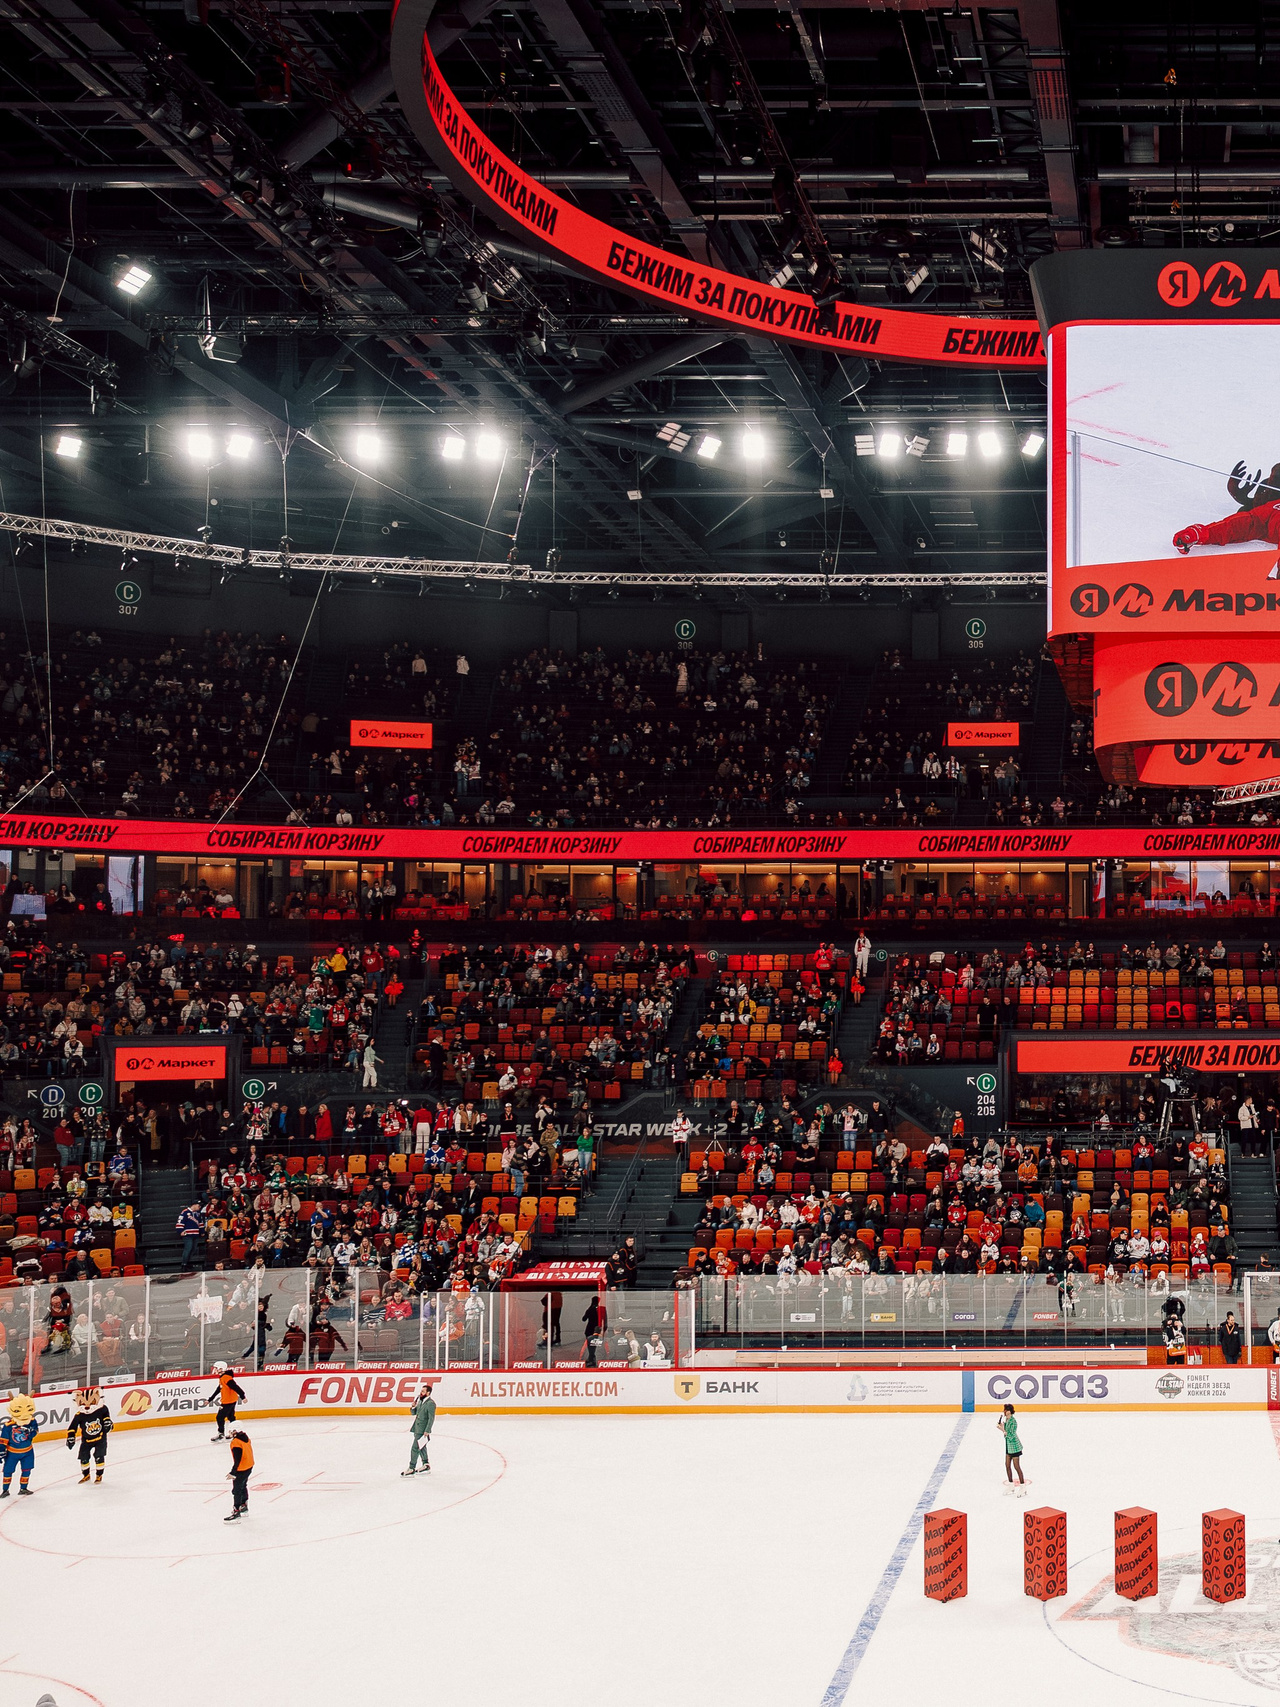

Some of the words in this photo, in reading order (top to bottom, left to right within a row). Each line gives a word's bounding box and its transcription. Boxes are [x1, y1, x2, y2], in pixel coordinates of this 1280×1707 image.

[444, 103, 459, 148] ЗА
[461, 129, 559, 236] ПОКУПКАМИ
[606, 241, 696, 298] БЕЖИМ
[694, 277, 725, 310] ЗА
[943, 327, 1041, 358] БЕЖИМ
[118, 605, 138, 615] 307
[677, 641, 693, 650] 306
[968, 640, 984, 649] 305
[381, 731, 425, 740] Маркет
[974, 731, 1013, 739] Маркет
[27, 822, 119, 844] КОРЗИНУ
[206, 829, 302, 850] СОБИРАЕМ
[304, 832, 385, 852] КОРЗИНУ
[462, 836, 548, 854] СОБИРАЕМ
[550, 837, 622, 854] КОРЗИНУ
[693, 836, 775, 854] СОБИРАЕМ
[776, 836, 847, 853] КОРЗИНУ
[918, 835, 1000, 852] СОБИРАЕМ
[1002, 835, 1072, 852] КОРЗИНУ
[1143, 833, 1225, 851] СОБИРАЕМ
[157, 1058, 216, 1069] Маркет
[1128, 1046, 1202, 1067] БЕЖИМ
[1205, 1046, 1228, 1066] ЗА
[977, 1095, 996, 1105] 204
[42, 1106, 65, 1118] 201
[977, 1106, 996, 1116] 205
[592, 1123, 641, 1137] STAR
[646, 1123, 702, 1136] WEK
[265, 1363, 297, 1371] FONBET
[315, 1362, 345, 1370] FONBET
[156, 1370, 191, 1380] FONBET
[158, 1386, 201, 1398] Яндекс
[297, 1376, 442, 1404] FONBET
[470, 1381, 619, 1398] ALLSTARWEEK.COM
[706, 1381, 760, 1394] БАНК
[1270, 1370, 1278, 1401] FONBET
[924, 1526, 964, 1560] Маркет
[1115, 1526, 1154, 1557] Маркет
[924, 1545, 964, 1578] Маркет
[1115, 1544, 1154, 1576] Маркет
[924, 1562, 964, 1595] Маркет
[1115, 1562, 1154, 1593] Маркет
